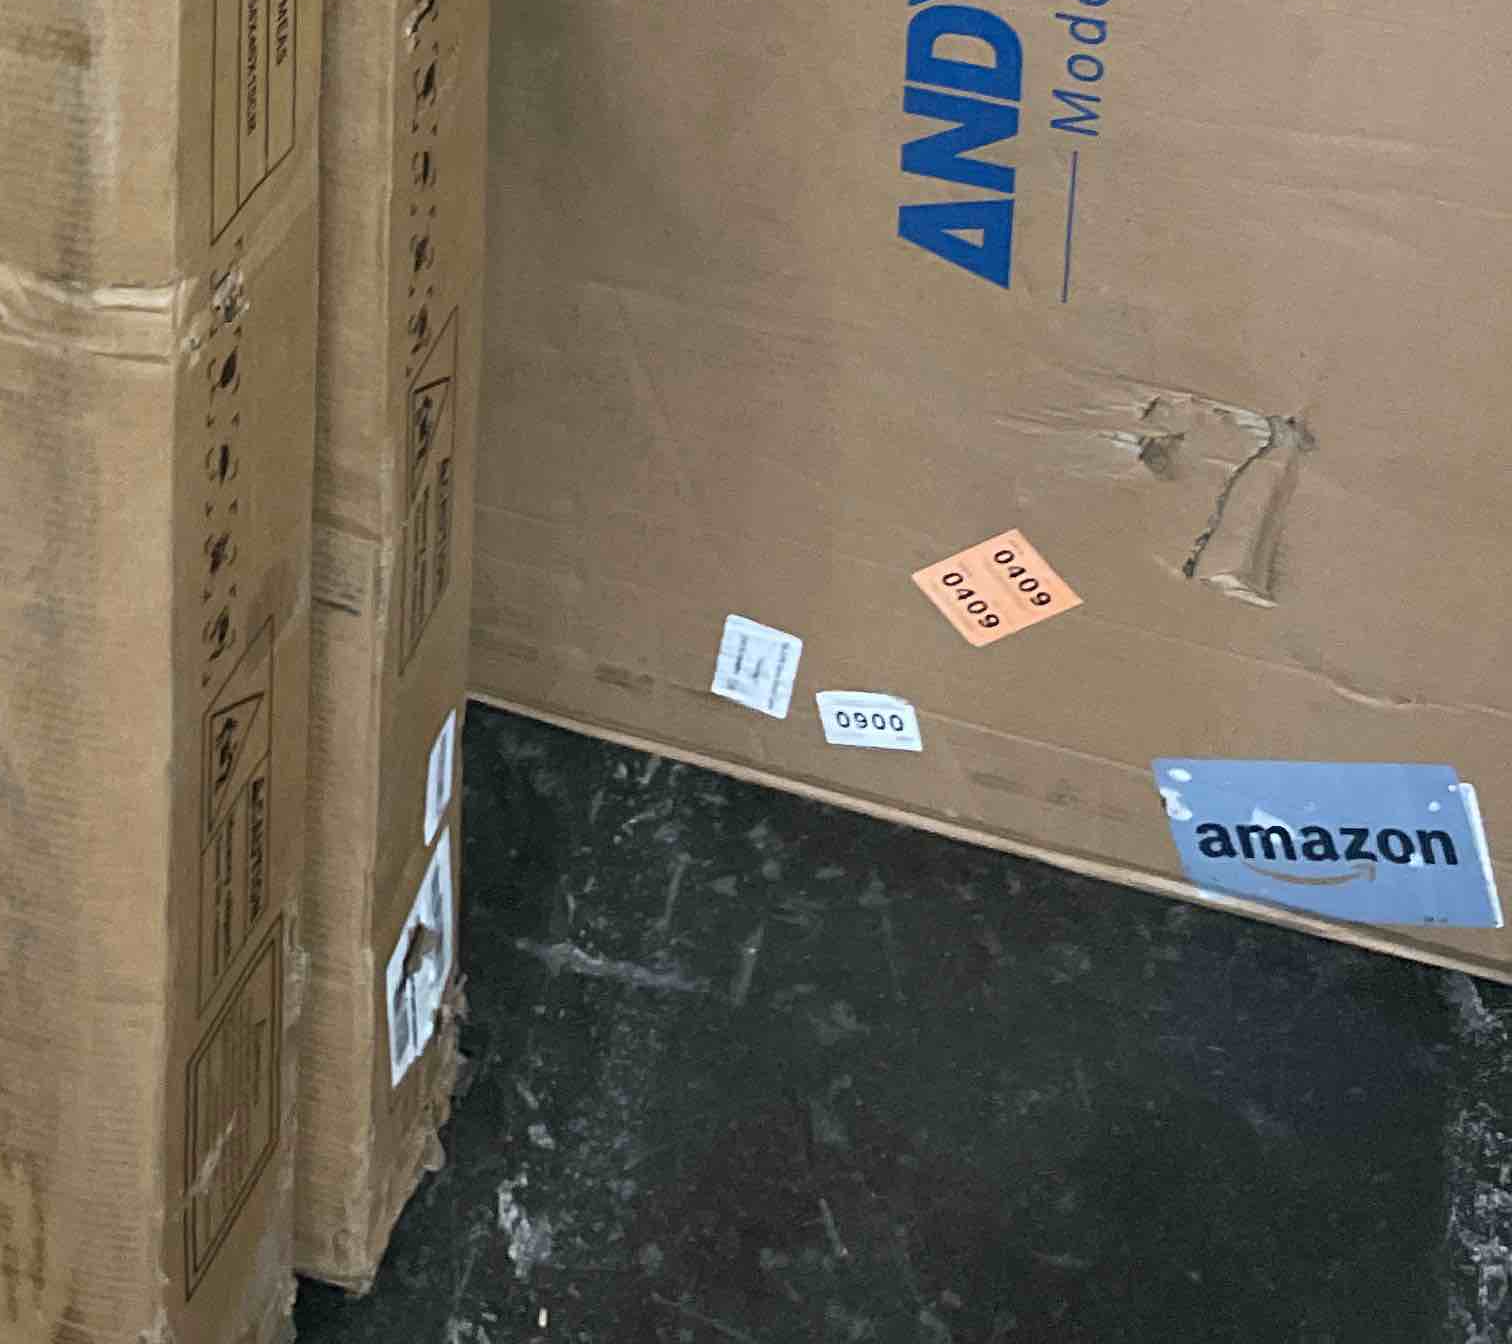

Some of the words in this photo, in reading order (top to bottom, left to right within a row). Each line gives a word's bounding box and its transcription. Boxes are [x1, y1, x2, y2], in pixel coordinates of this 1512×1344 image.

[942, 573, 1000, 628] 0409
[994, 550, 1051, 606] 0409
[835, 710, 904, 733] 0900
[1196, 818, 1457, 867] amazon
